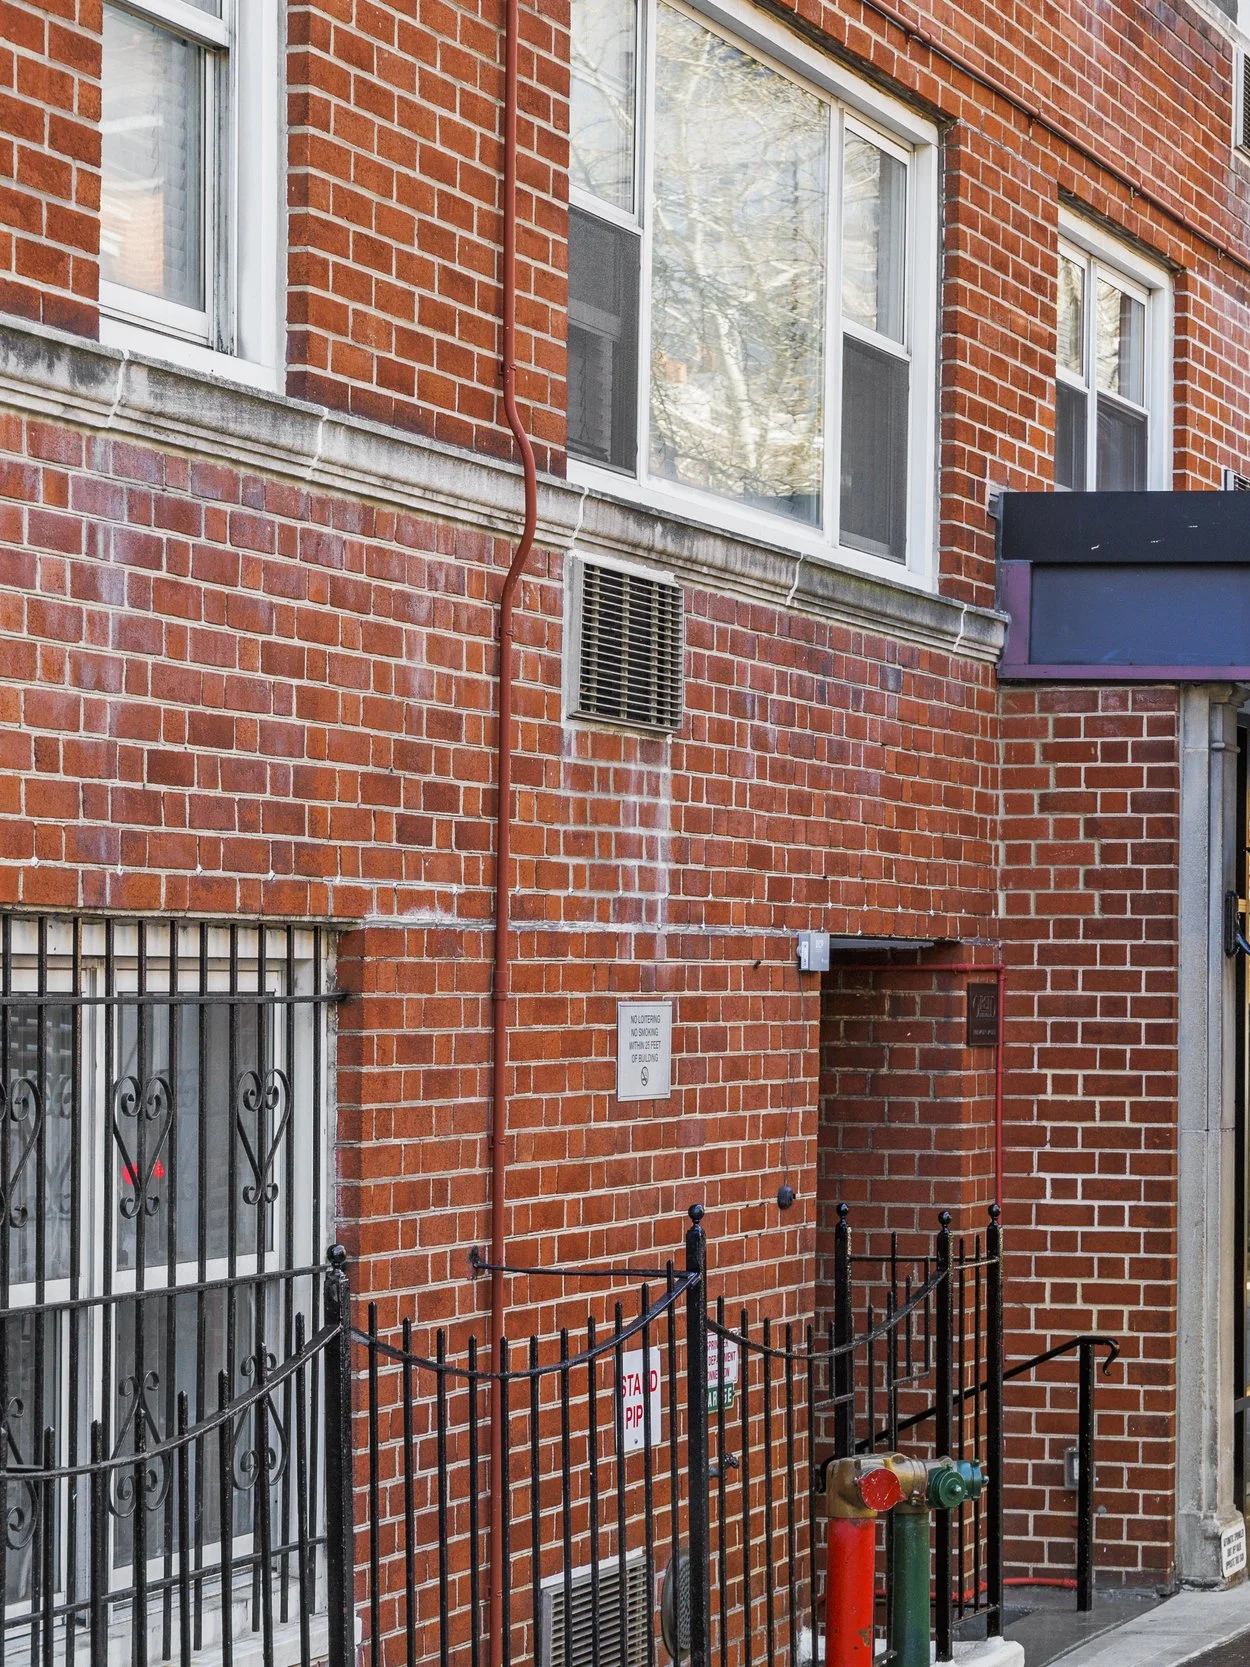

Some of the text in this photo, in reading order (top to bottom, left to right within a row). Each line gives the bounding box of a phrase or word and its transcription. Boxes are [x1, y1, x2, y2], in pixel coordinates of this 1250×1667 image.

[630, 1014, 661, 1024] NO LOITERING
[631, 1027, 659, 1037] NO SMOKING
[629, 1040, 662, 1050] WITHIN 25 FEET
[631, 1053, 659, 1063] OF BUILDING
[622, 1369, 658, 1399] STAD
[625, 1404, 645, 1430] PIP
